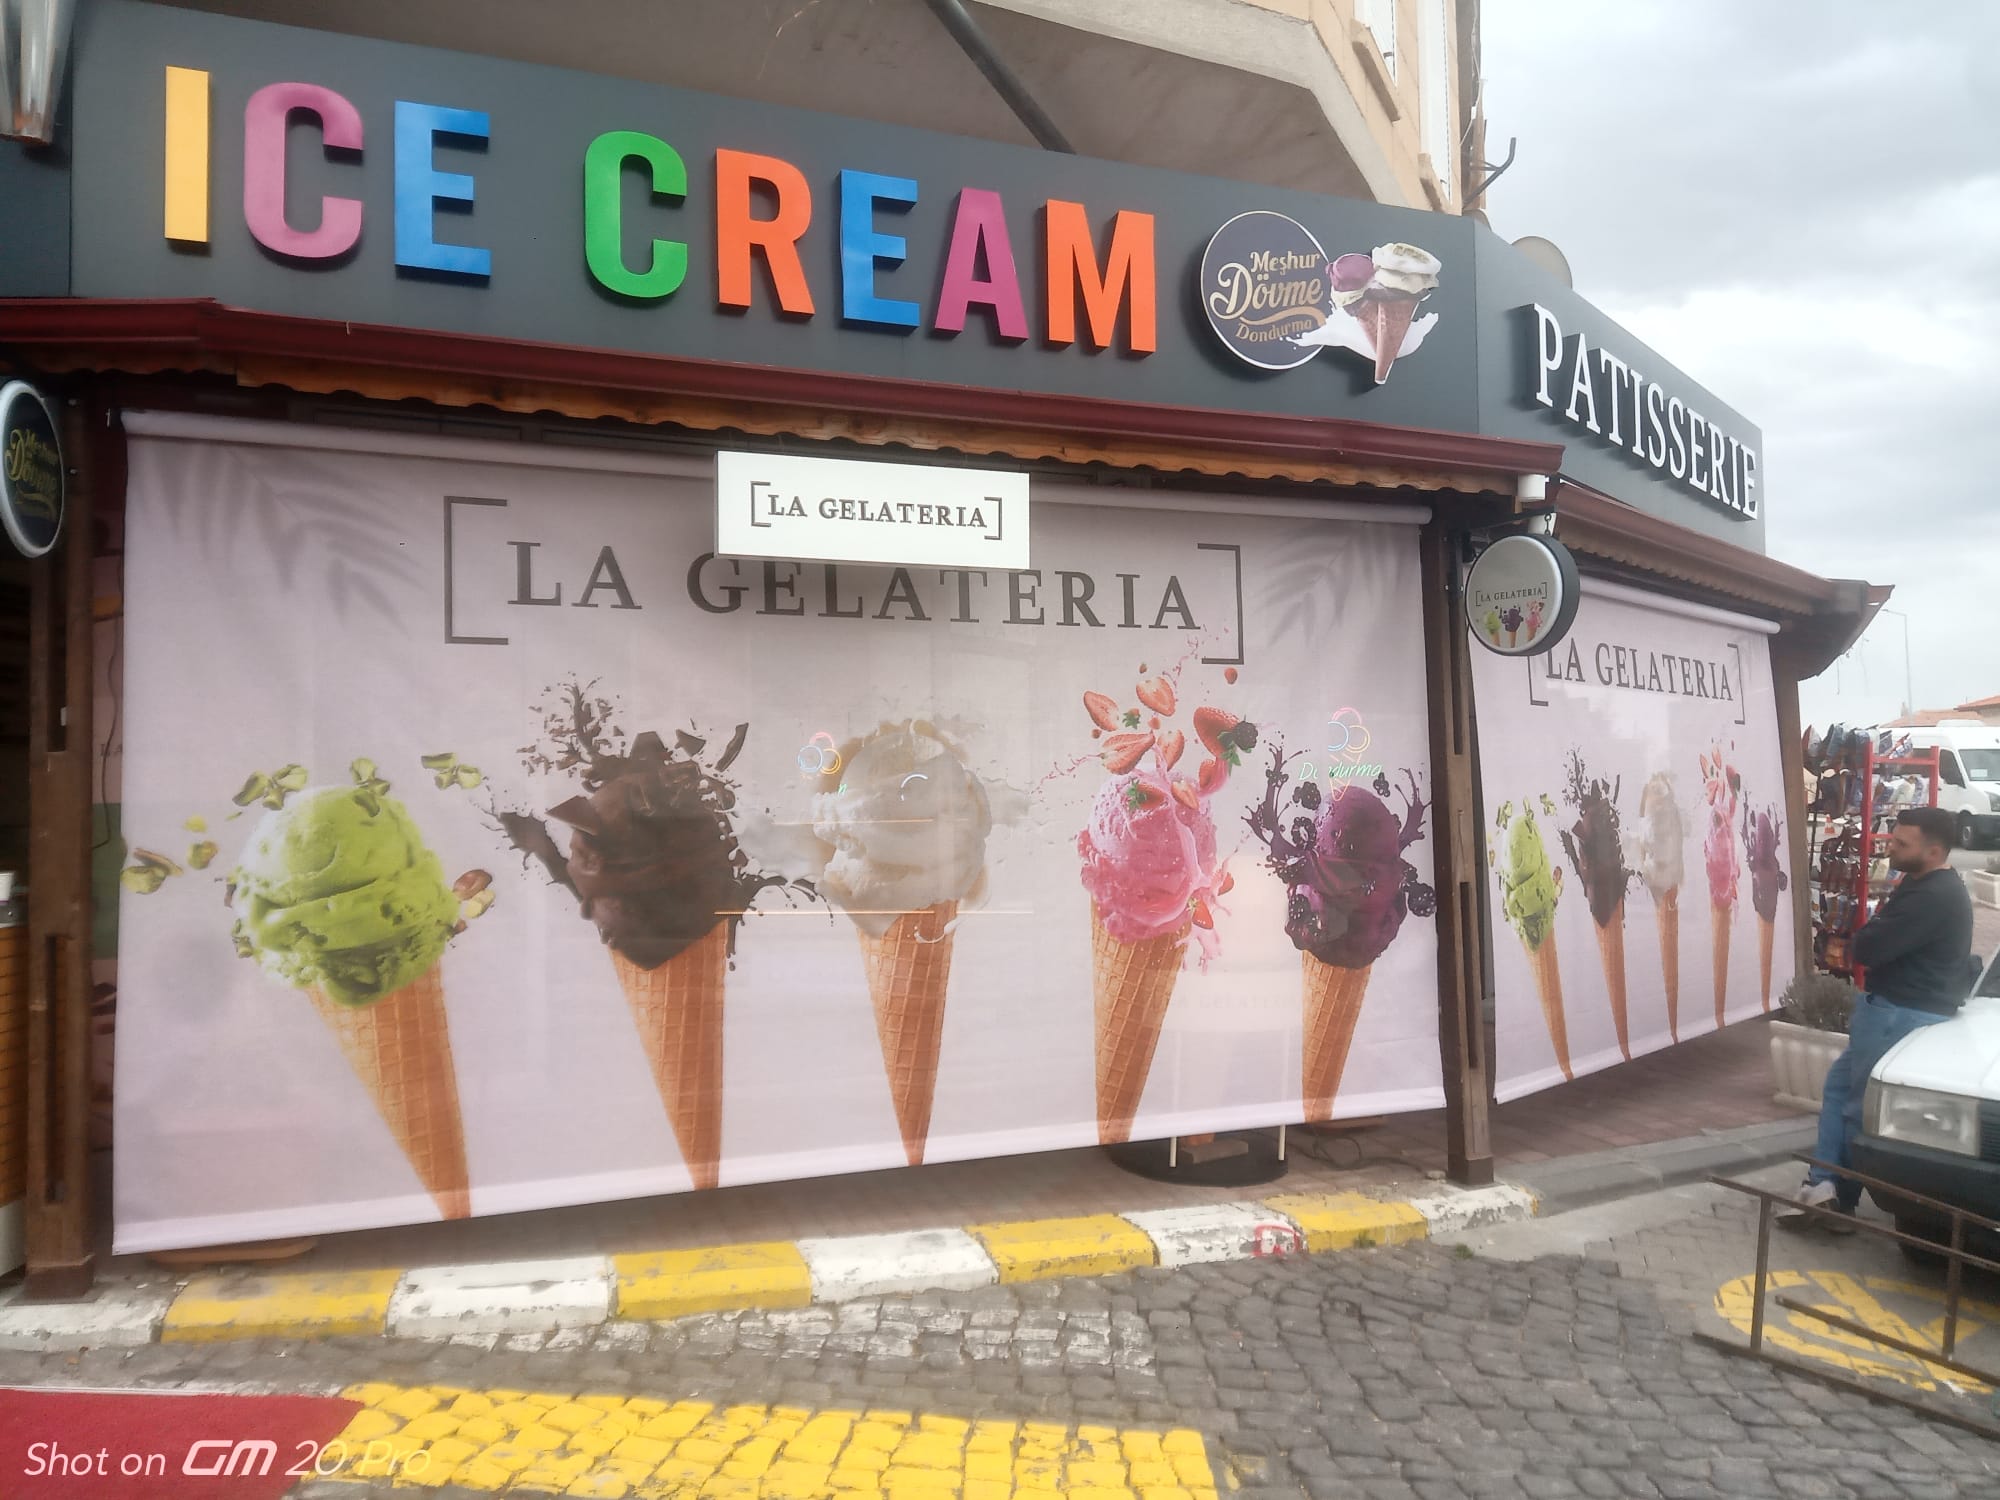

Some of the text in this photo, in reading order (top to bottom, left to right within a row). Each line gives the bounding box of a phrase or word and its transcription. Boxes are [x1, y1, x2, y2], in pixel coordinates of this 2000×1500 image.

[164, 65, 1157, 354] ICE CREAM
[1209, 262, 1324, 320] Dövme
[1250, 250, 1320, 275] Meşhur
[1235, 319, 1313, 342] Dondurma
[1533, 302, 1759, 520] PATISSERIE
[767, 494, 988, 528] LA GELATERIA
[506, 540, 1201, 631] LA GELATERIA
[1480, 587, 1543, 602] LA GELATERIA
[1546, 637, 1734, 701] LA GELATERIA
